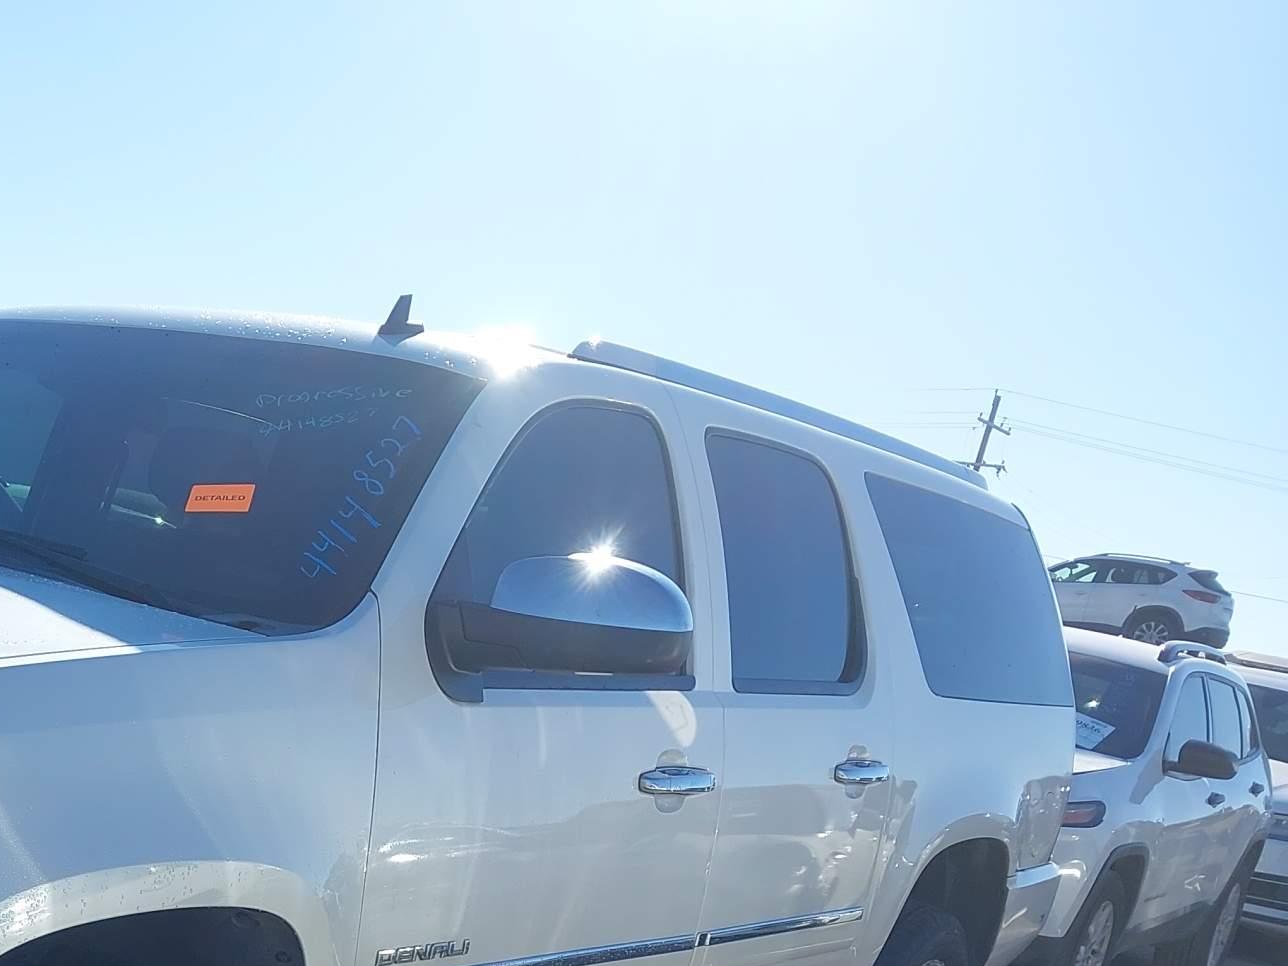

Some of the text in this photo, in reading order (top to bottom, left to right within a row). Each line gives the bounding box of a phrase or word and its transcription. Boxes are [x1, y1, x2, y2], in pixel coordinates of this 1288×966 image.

[194, 494, 247, 502] DETAILED
[300, 415, 423, 578] 44148527
[374, 937, 471, 966] DENALI
